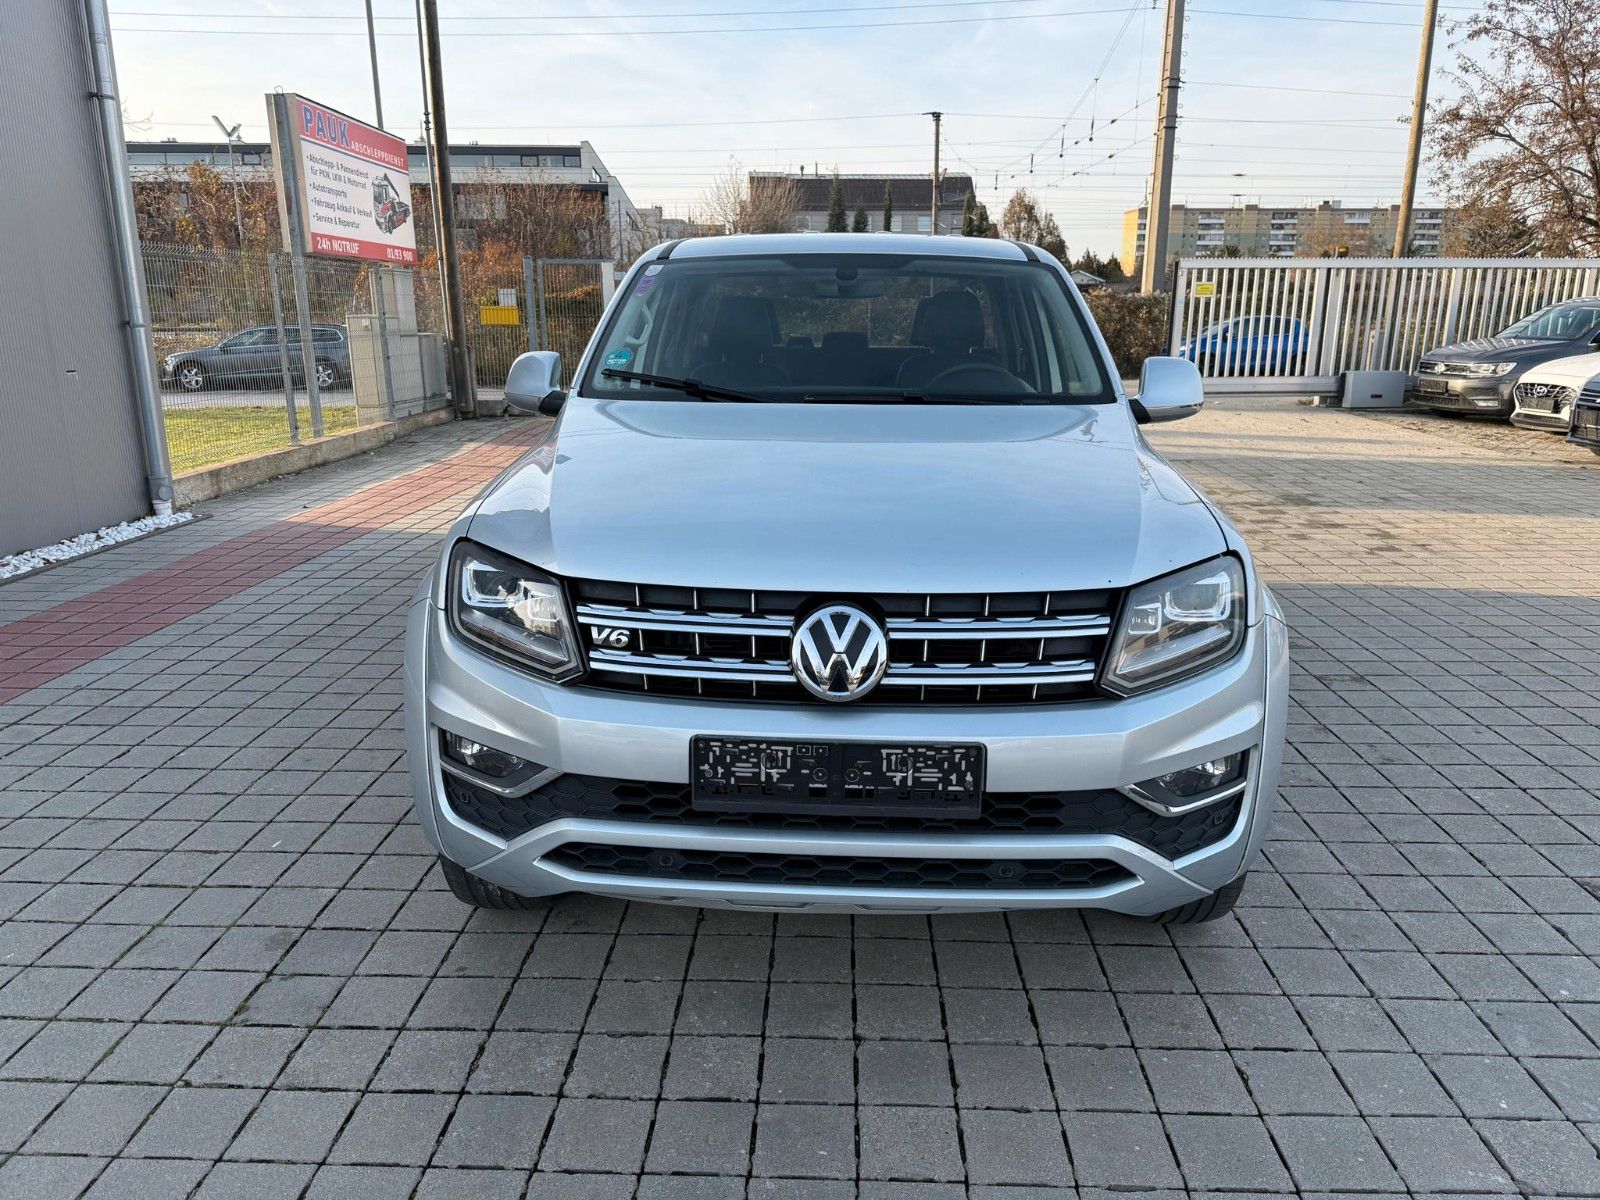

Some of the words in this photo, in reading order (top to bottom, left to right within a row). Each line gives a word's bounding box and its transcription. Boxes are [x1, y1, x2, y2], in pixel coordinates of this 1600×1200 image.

[302, 105, 350, 148] PAUK
[350, 140, 404, 167] ABSCHLEPPDIENST
[313, 197, 336, 211] Fahrzeug
[336, 203, 352, 213] Ankauf
[356, 206, 372, 218] Verkauf
[315, 212, 333, 224] Service
[338, 218, 360, 229] Reparatur
[316, 236, 331, 250] 24h
[332, 239, 360, 254] NOTRUF
[590, 626, 630, 648] V6
